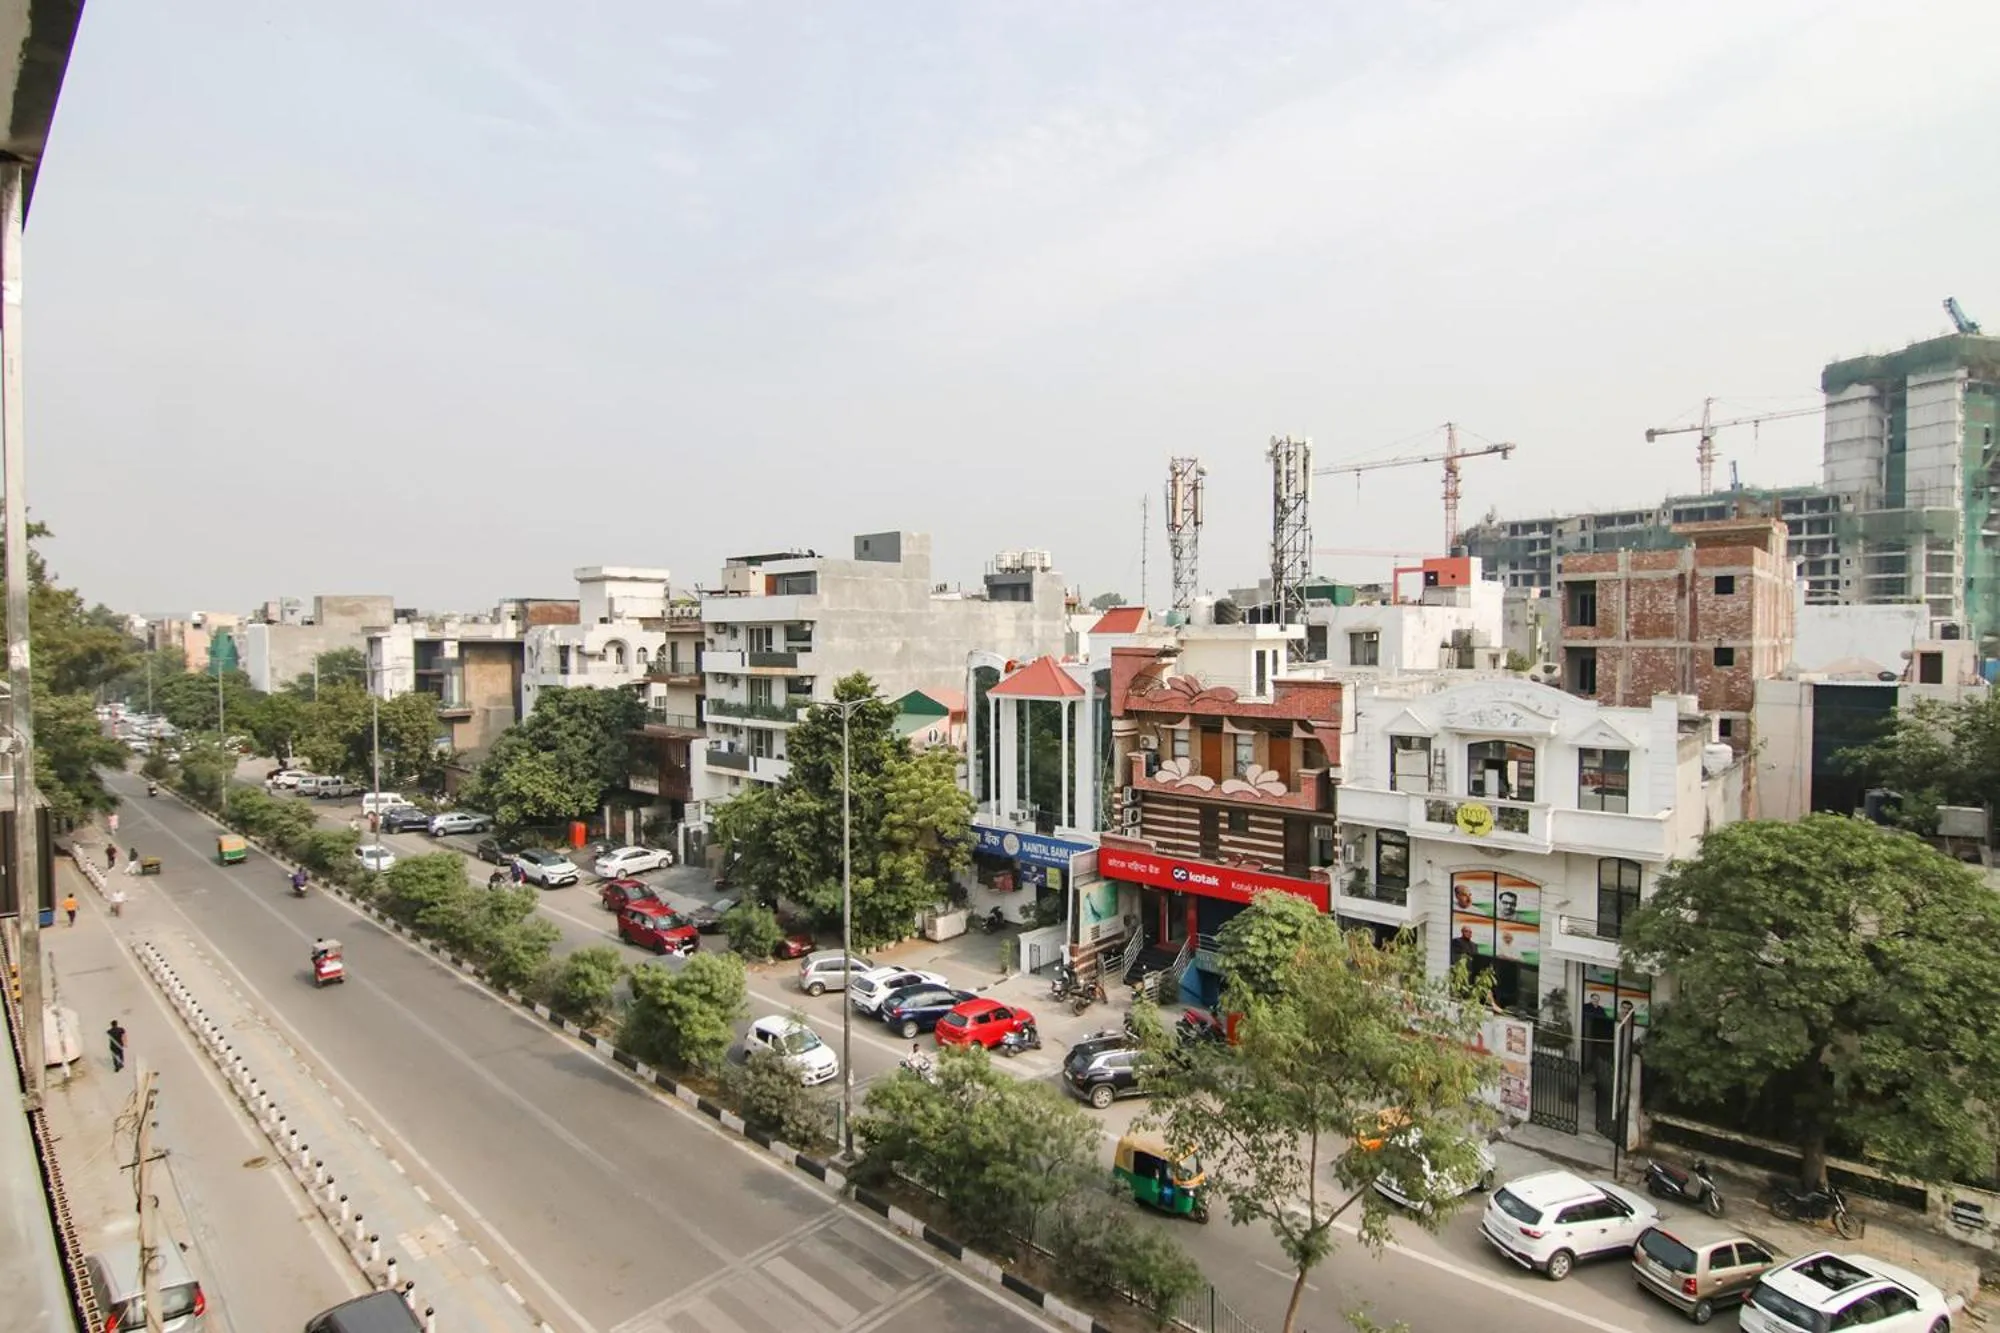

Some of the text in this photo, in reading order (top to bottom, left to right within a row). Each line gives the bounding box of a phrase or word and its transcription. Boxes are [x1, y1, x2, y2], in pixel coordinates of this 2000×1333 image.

[1022, 841, 1049, 856] NAINITAL
[1050, 846, 1069, 859] BANK
[1189, 871, 1219, 886] kotak
